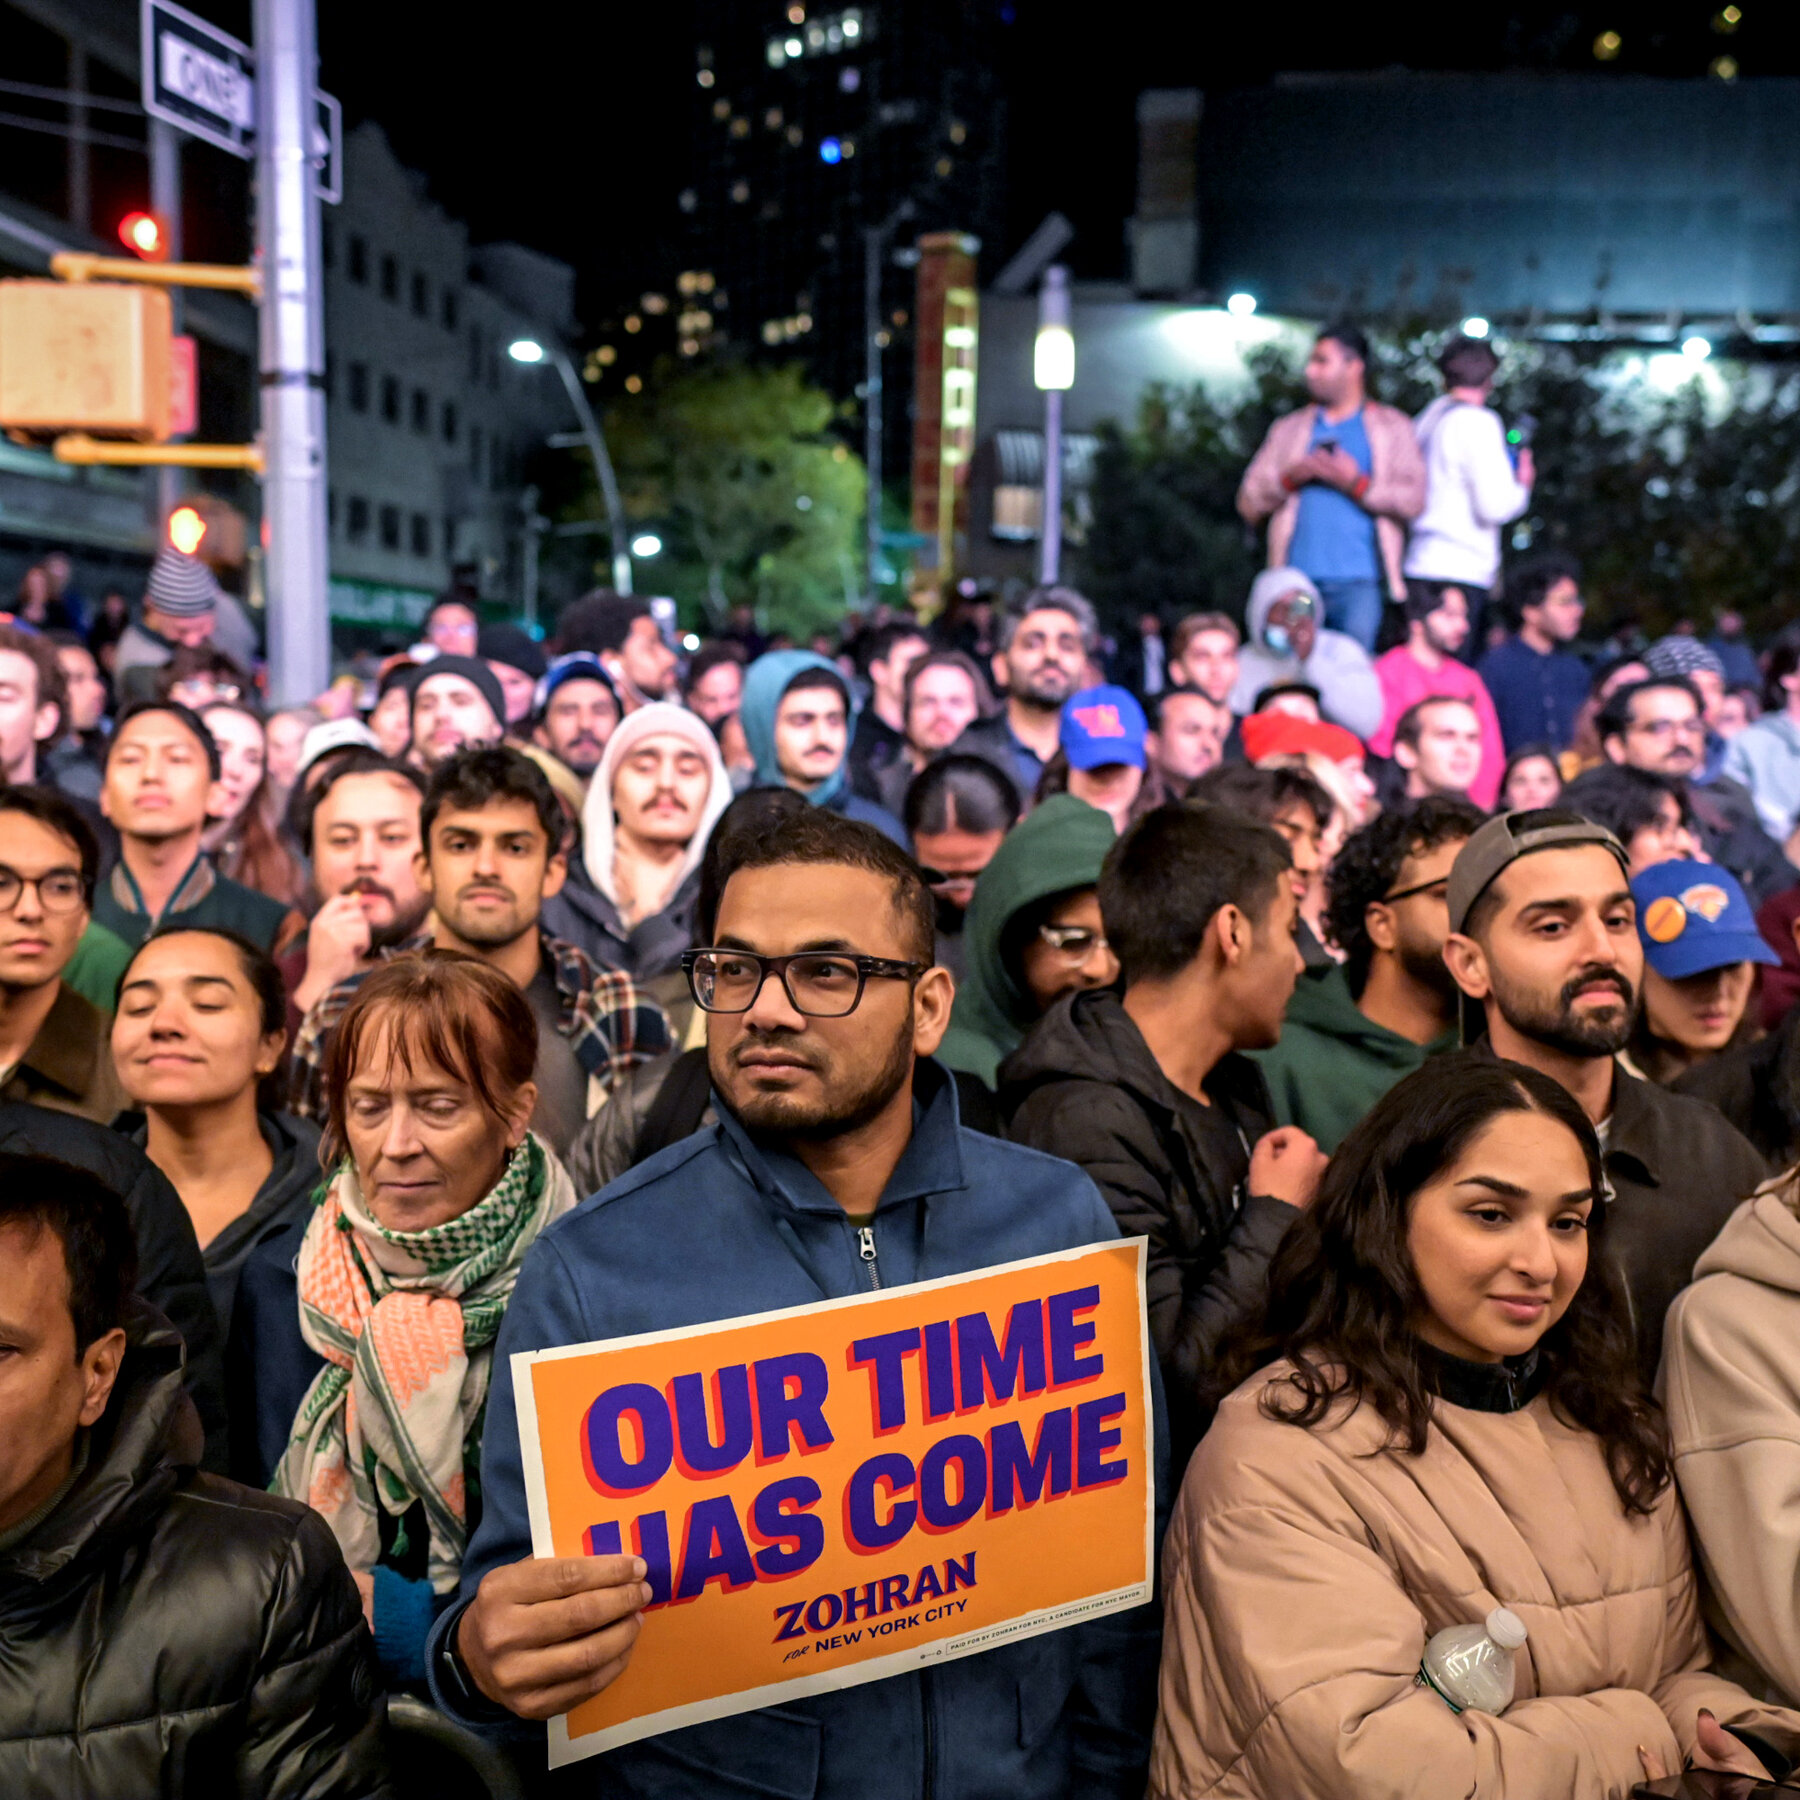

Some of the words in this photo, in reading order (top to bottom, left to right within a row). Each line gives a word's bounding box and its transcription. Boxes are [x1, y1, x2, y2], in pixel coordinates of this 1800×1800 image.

[581, 1352, 835, 1498] OUR
[847, 1284, 1104, 1438] TIME
[583, 1476, 825, 1613] HAS
[843, 1392, 1129, 1556] COME
[772, 1551, 978, 1644] ZOHRAN
[782, 1645, 810, 1663] FOR
[815, 1630, 863, 1653] NEW
[867, 1614, 920, 1638] YORK
[925, 1598, 968, 1622] CITY
[950, 1641, 966, 1650] PAID
[967, 1637, 981, 1645] FOR
[991, 1626, 1018, 1638] ZOHRAN
[1018, 1621, 1032, 1629] FOR
[1055, 1605, 1090, 1619] CANDIDATE
